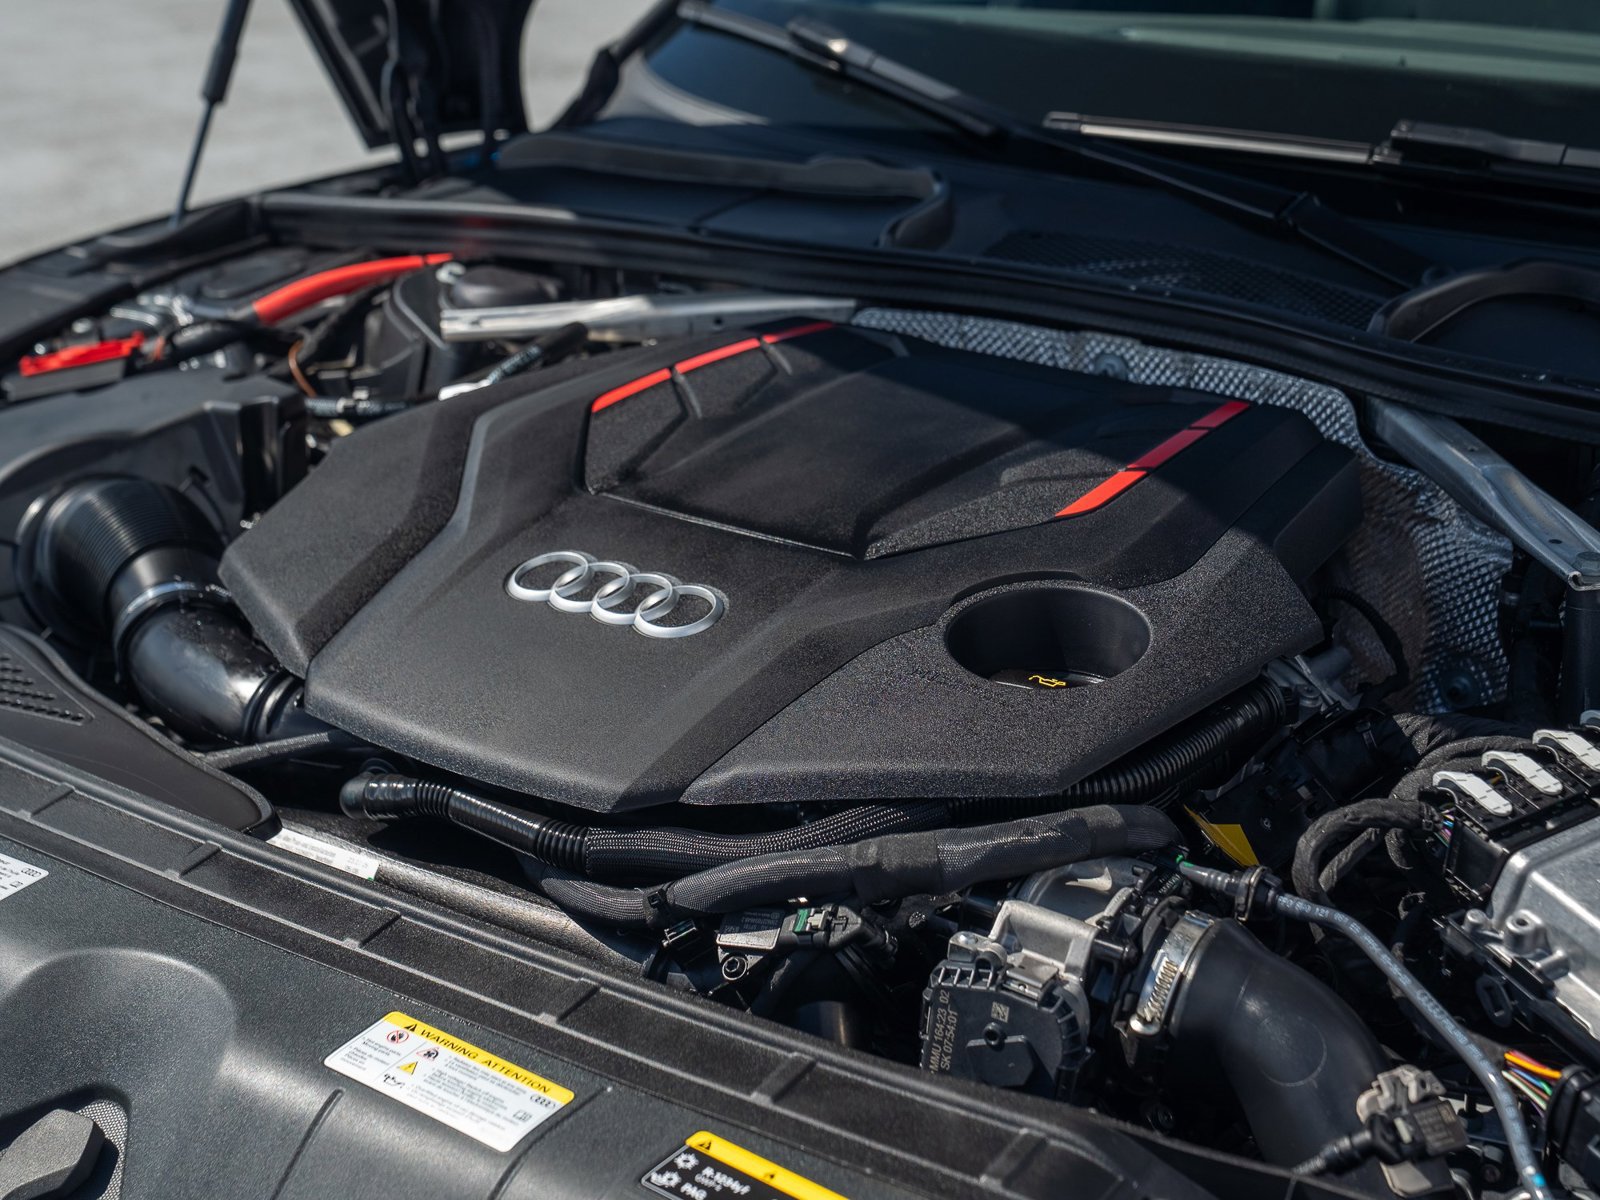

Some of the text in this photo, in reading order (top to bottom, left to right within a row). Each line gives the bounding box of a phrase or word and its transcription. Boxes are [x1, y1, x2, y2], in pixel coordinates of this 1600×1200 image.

[939, 989, 950, 1004] 02
[420, 1029, 478, 1060] WARNING
[482, 1059, 551, 1093] ATTENTION
[940, 1053, 952, 1070] SK
[681, 1182, 707, 1200] PAG
